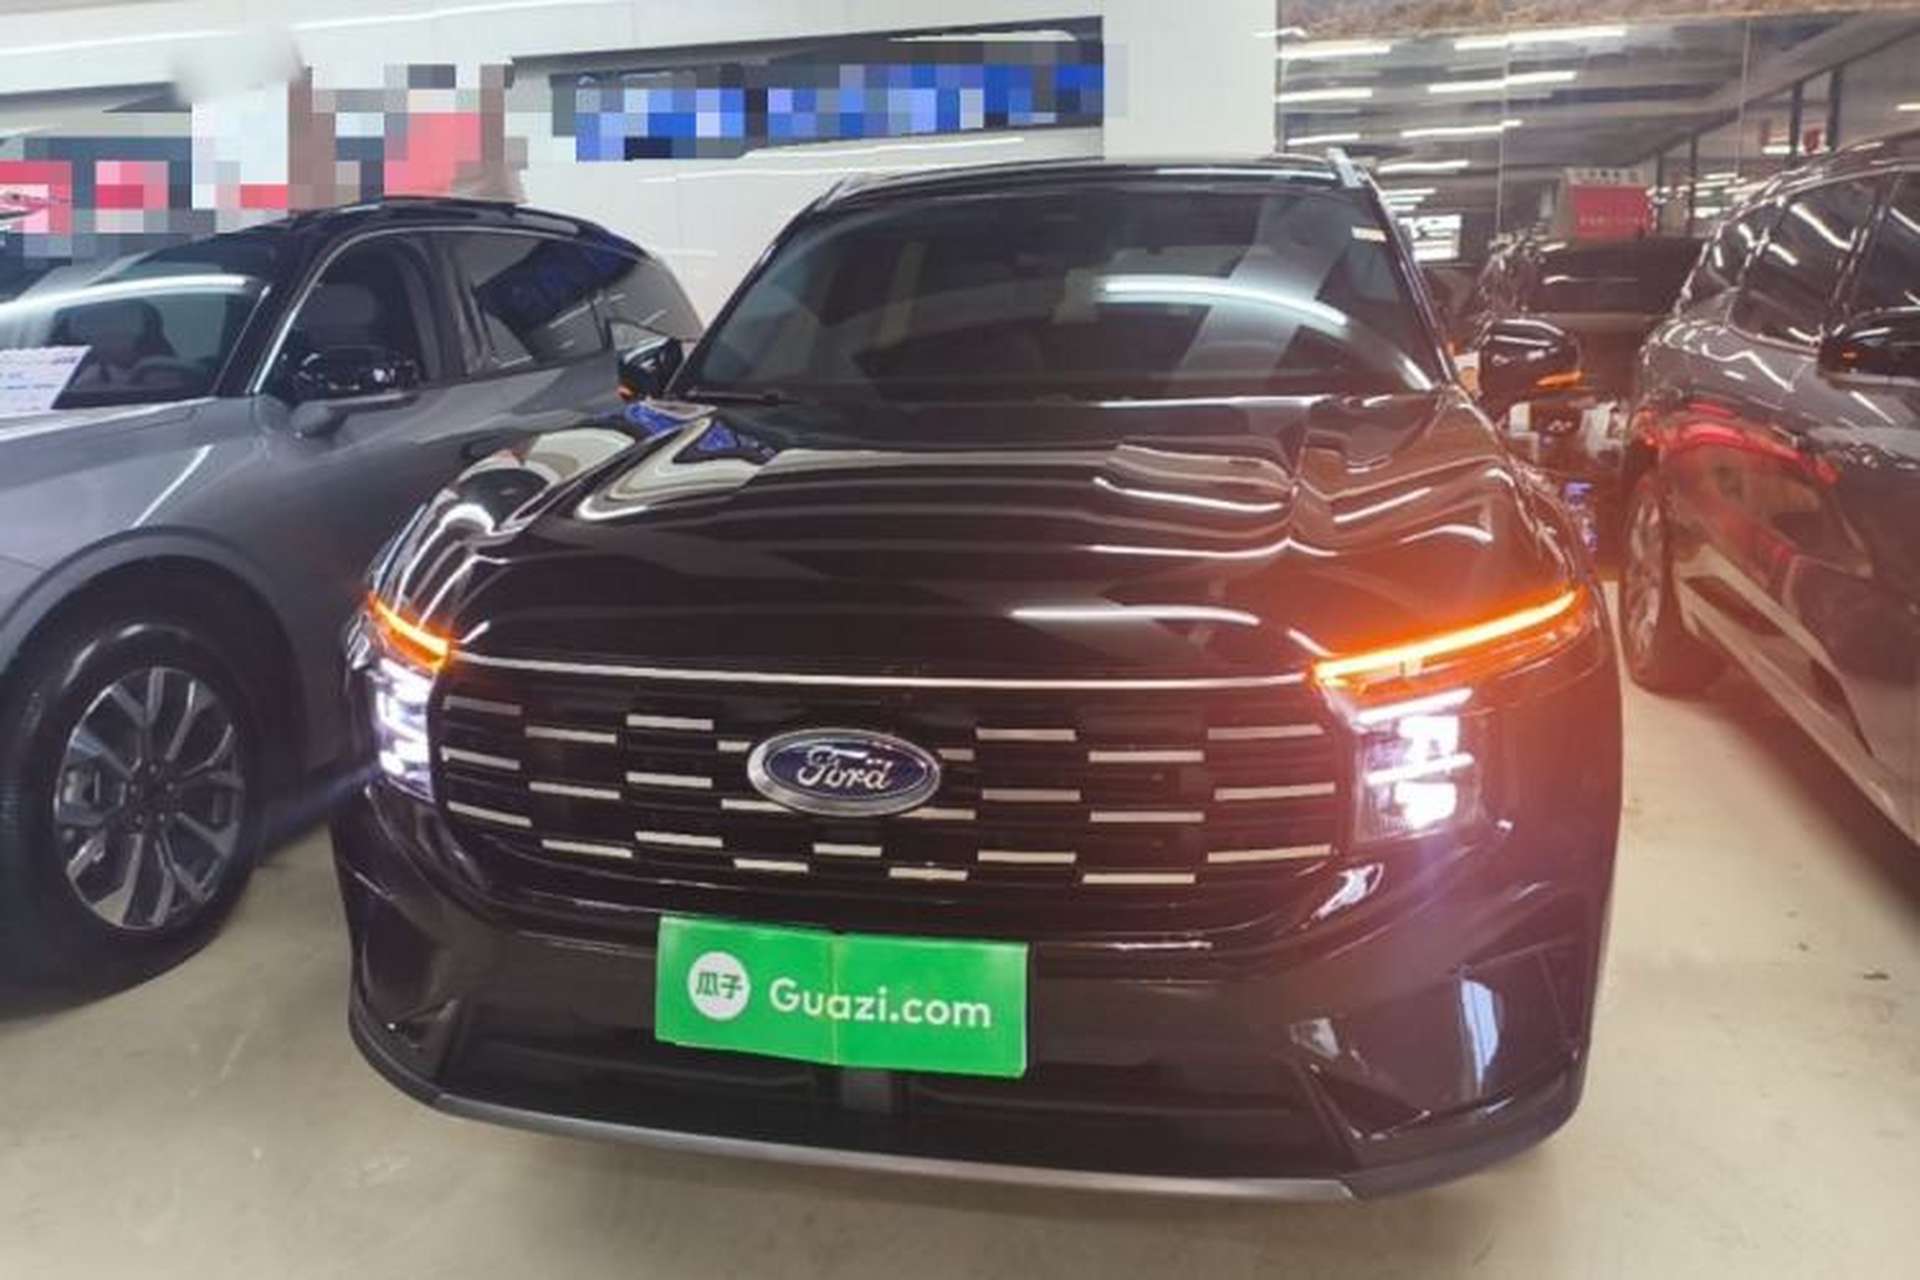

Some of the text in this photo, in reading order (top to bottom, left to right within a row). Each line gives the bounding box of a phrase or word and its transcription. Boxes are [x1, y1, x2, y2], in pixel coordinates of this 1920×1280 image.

[798, 745, 893, 789] Ford
[695, 972, 744, 999] 瓜子
[768, 977, 992, 1028] Guazi.com
